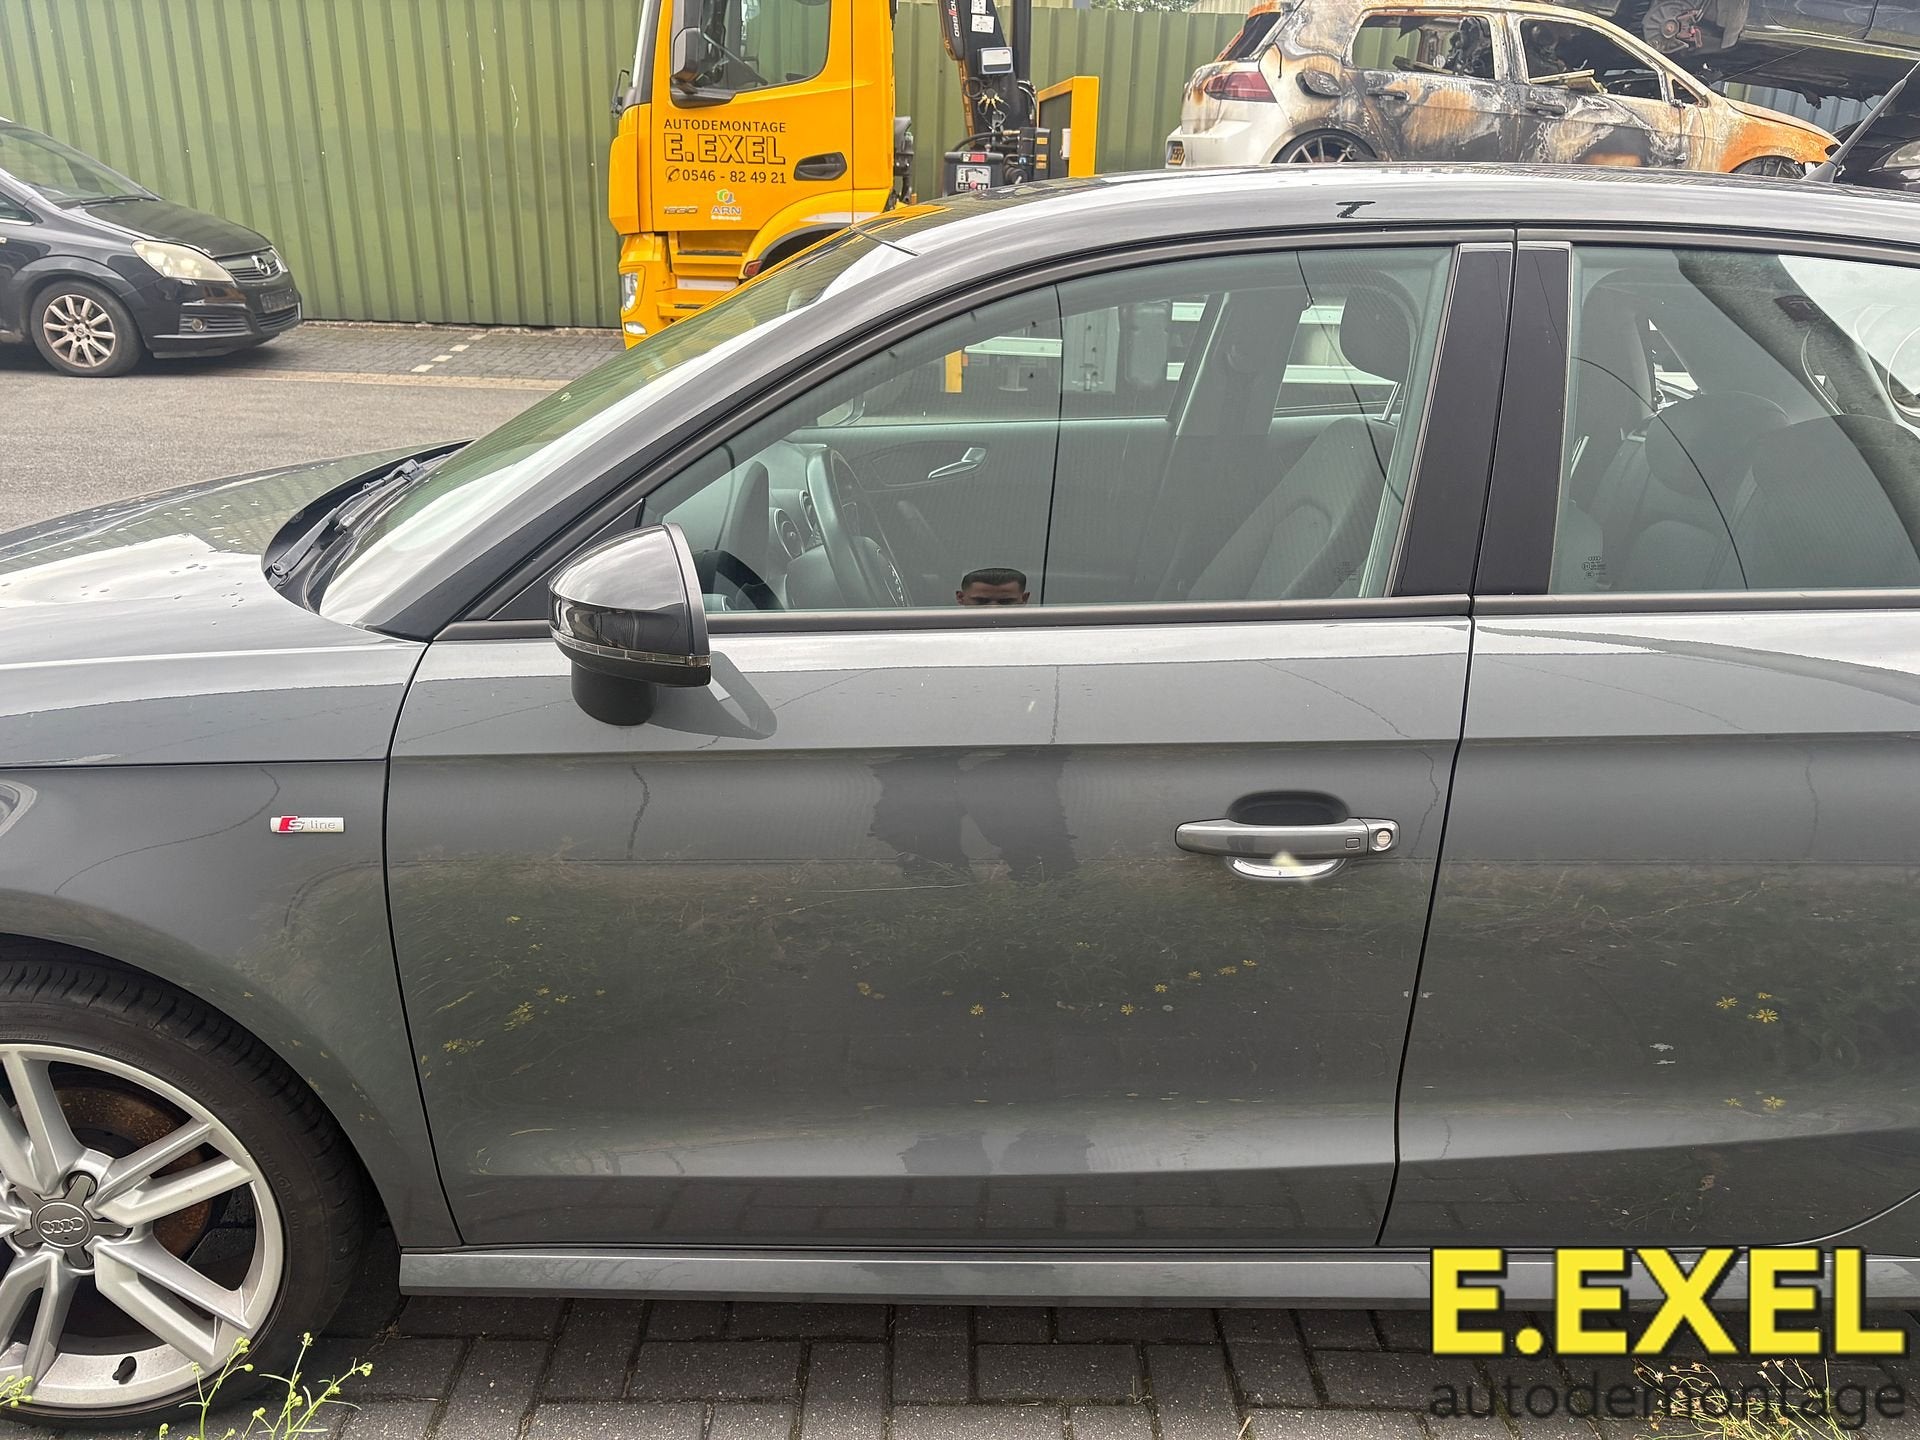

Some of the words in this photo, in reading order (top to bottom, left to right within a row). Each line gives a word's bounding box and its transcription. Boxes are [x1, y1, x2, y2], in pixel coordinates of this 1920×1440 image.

[664, 119, 786, 133] AUTODEMONTAGE
[663, 132, 786, 165] E.EXEL
[682, 169, 716, 182] 0546
[729, 171, 747, 183] 82
[750, 171, 767, 184] 49
[770, 172, 787, 184] 21
[711, 206, 741, 214] ARN
[310, 820, 336, 829] line
